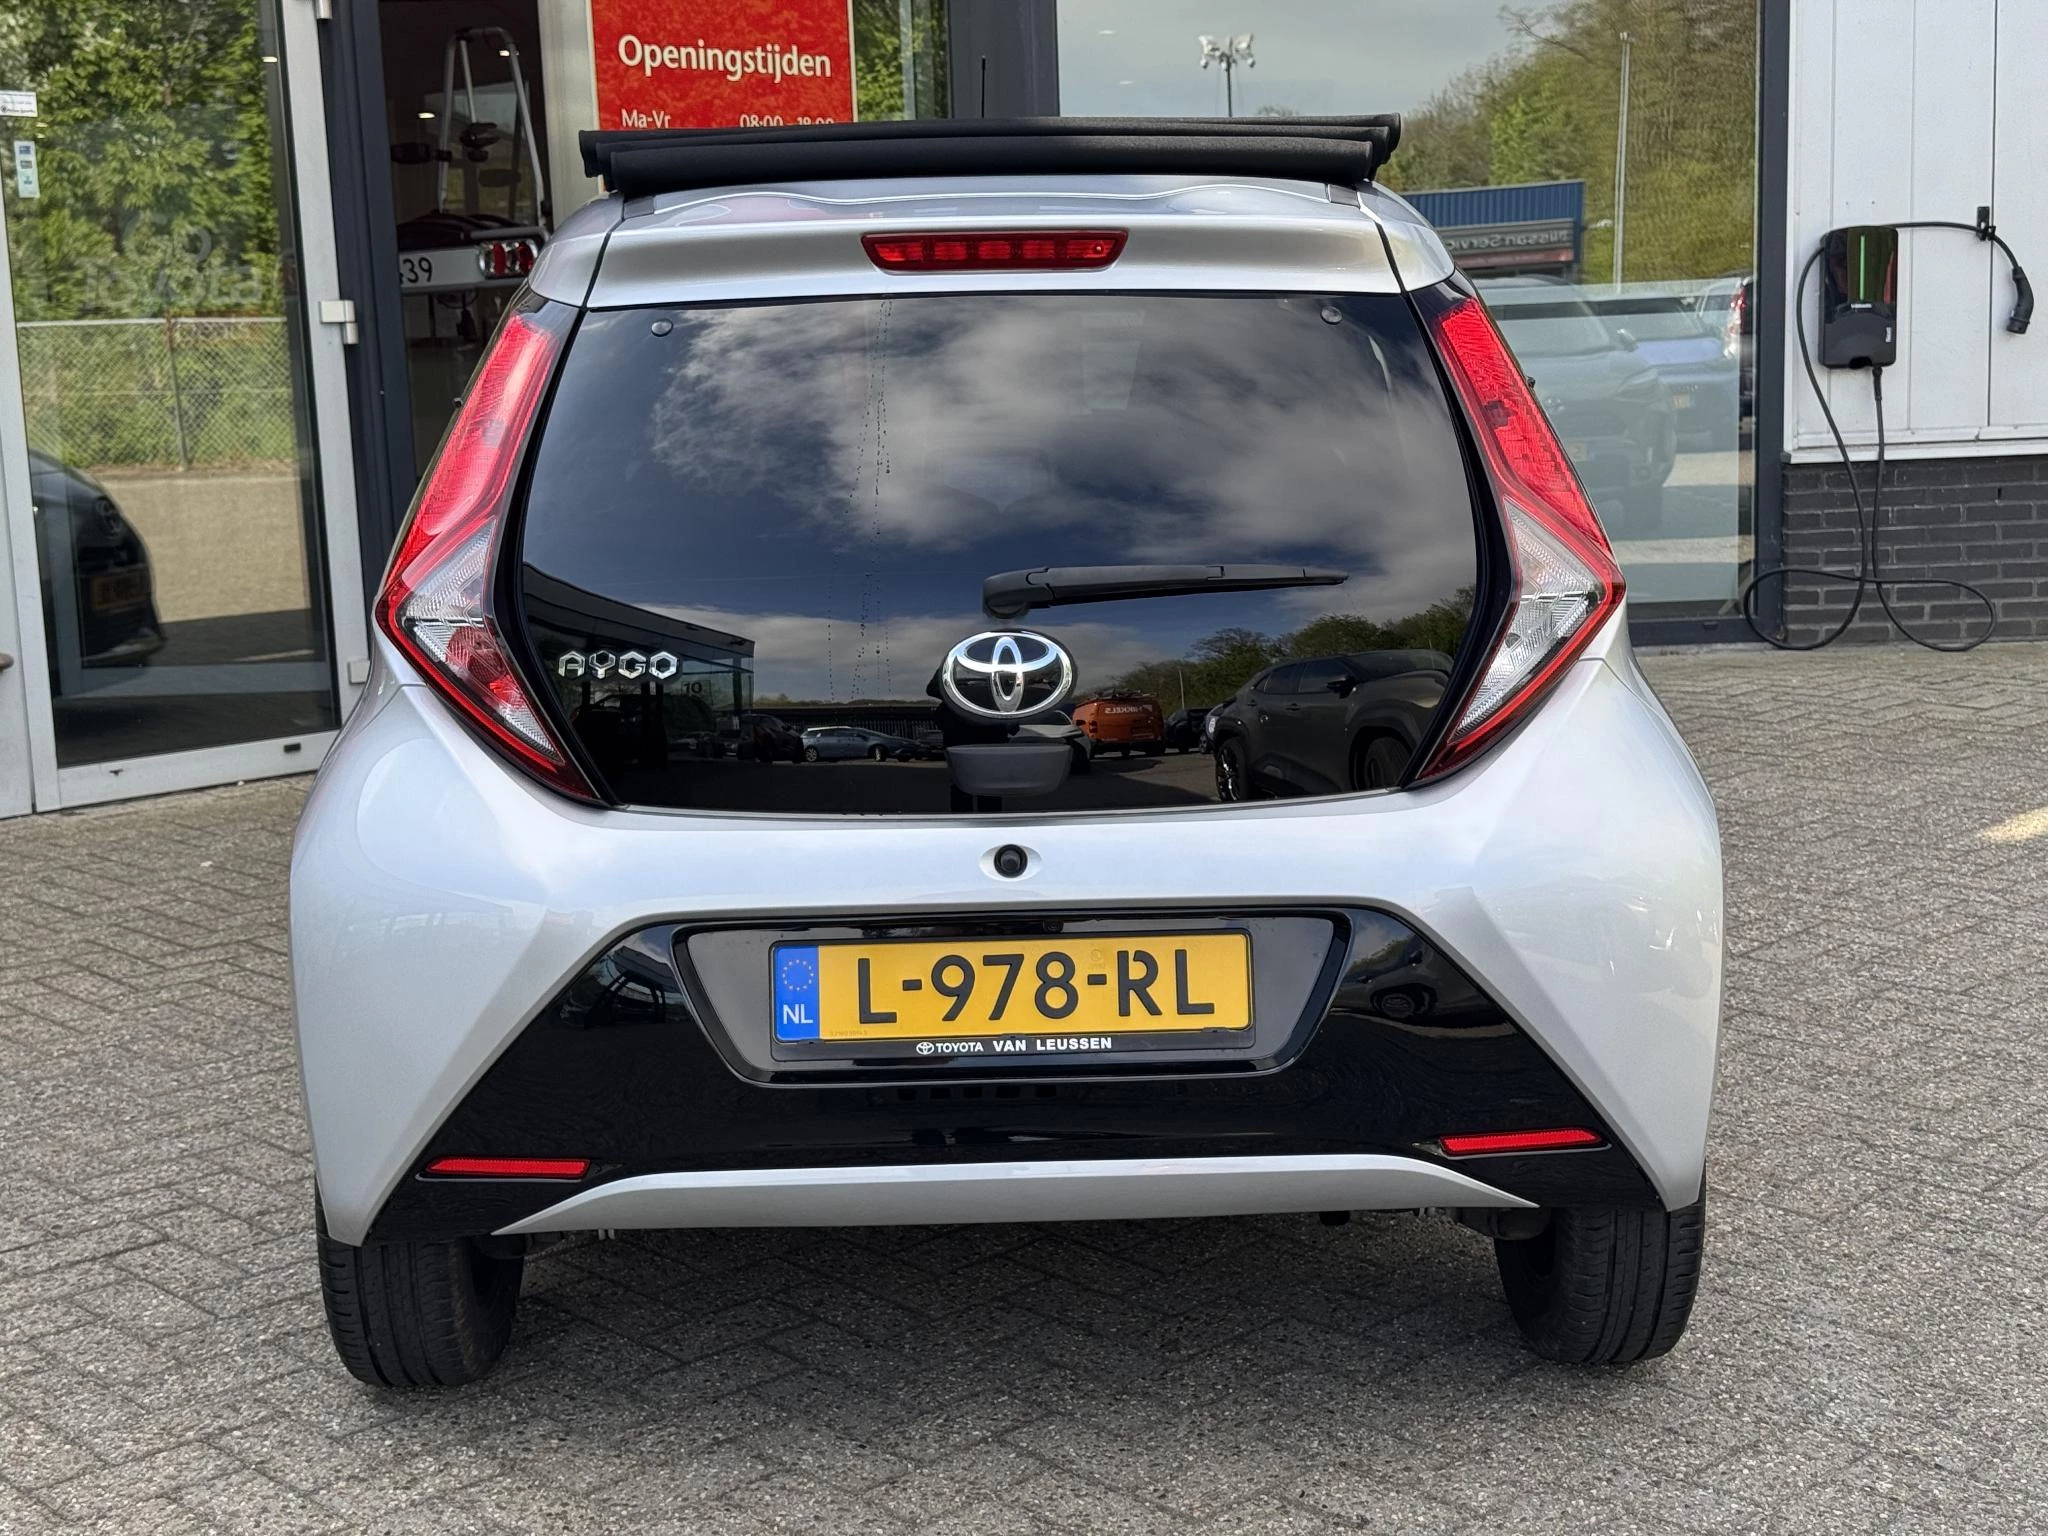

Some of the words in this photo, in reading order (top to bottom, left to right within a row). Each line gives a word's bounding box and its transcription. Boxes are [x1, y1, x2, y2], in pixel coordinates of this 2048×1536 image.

[618, 34, 831, 83] Openingstijden
[621, 108, 671, 129] Ma-Vr
[400, 257, 432, 284] 39
[558, 650, 678, 680] AYGO
[858, 949, 1215, 1024] L-978-RL
[783, 1003, 814, 1024] NL
[936, 1042, 984, 1053] TOYOTA
[992, 1040, 1027, 1052] VAN
[1036, 1037, 1112, 1051] LEUSSEN
